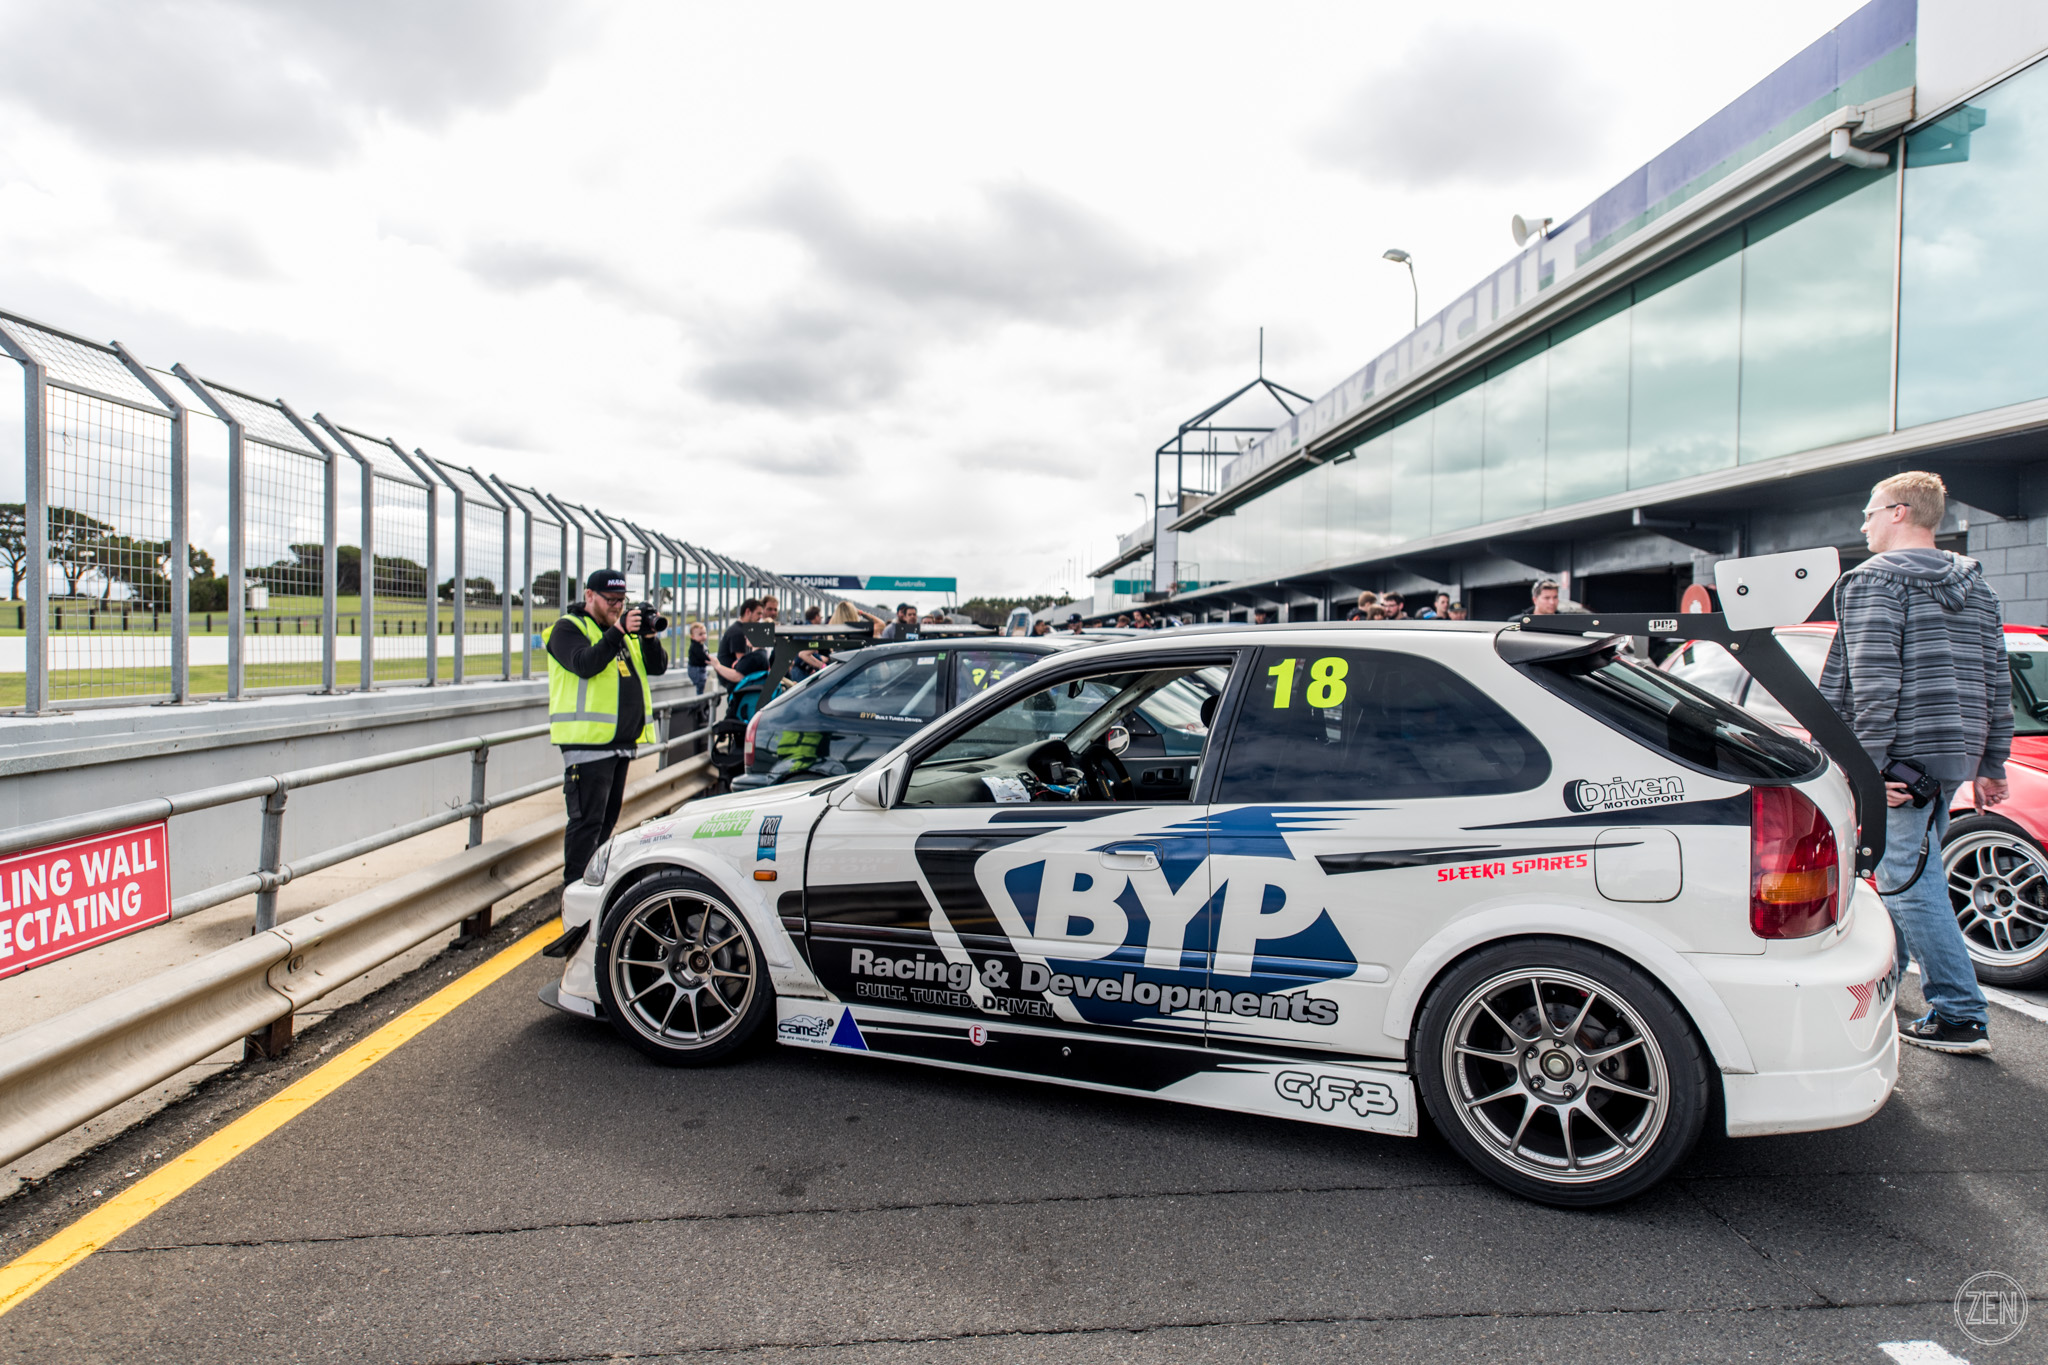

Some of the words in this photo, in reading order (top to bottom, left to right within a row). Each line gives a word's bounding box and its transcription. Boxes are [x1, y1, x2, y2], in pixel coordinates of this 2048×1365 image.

[894, 580, 926, 588] Australia
[1268, 657, 1348, 708] 18
[1586, 776, 1685, 806] Driven
[1604, 794, 1685, 810] MOTORSPORT
[653, 834, 673, 842] ATTACK
[761, 816, 780, 835] PRO
[759, 835, 776, 848] WRAPS
[0, 858, 73, 912] LING
[80, 838, 157, 888] WALL
[1438, 862, 1505, 882] SLEEKA
[1512, 854, 1588, 875] SPARES
[0, 882, 141, 959] ECTATING
[1034, 854, 1326, 977] BYP
[851, 948, 972, 991] Racing
[980, 959, 1011, 989] &
[1020, 961, 1338, 1026] Developments
[856, 982, 908, 1001] BUILT.
[910, 987, 979, 1008] TUNED.
[982, 995, 1054, 1018] DRIVEN
[778, 1023, 820, 1037] cams
[973, 1027, 981, 1043] E
[1275, 1070, 1398, 1118] GFB
